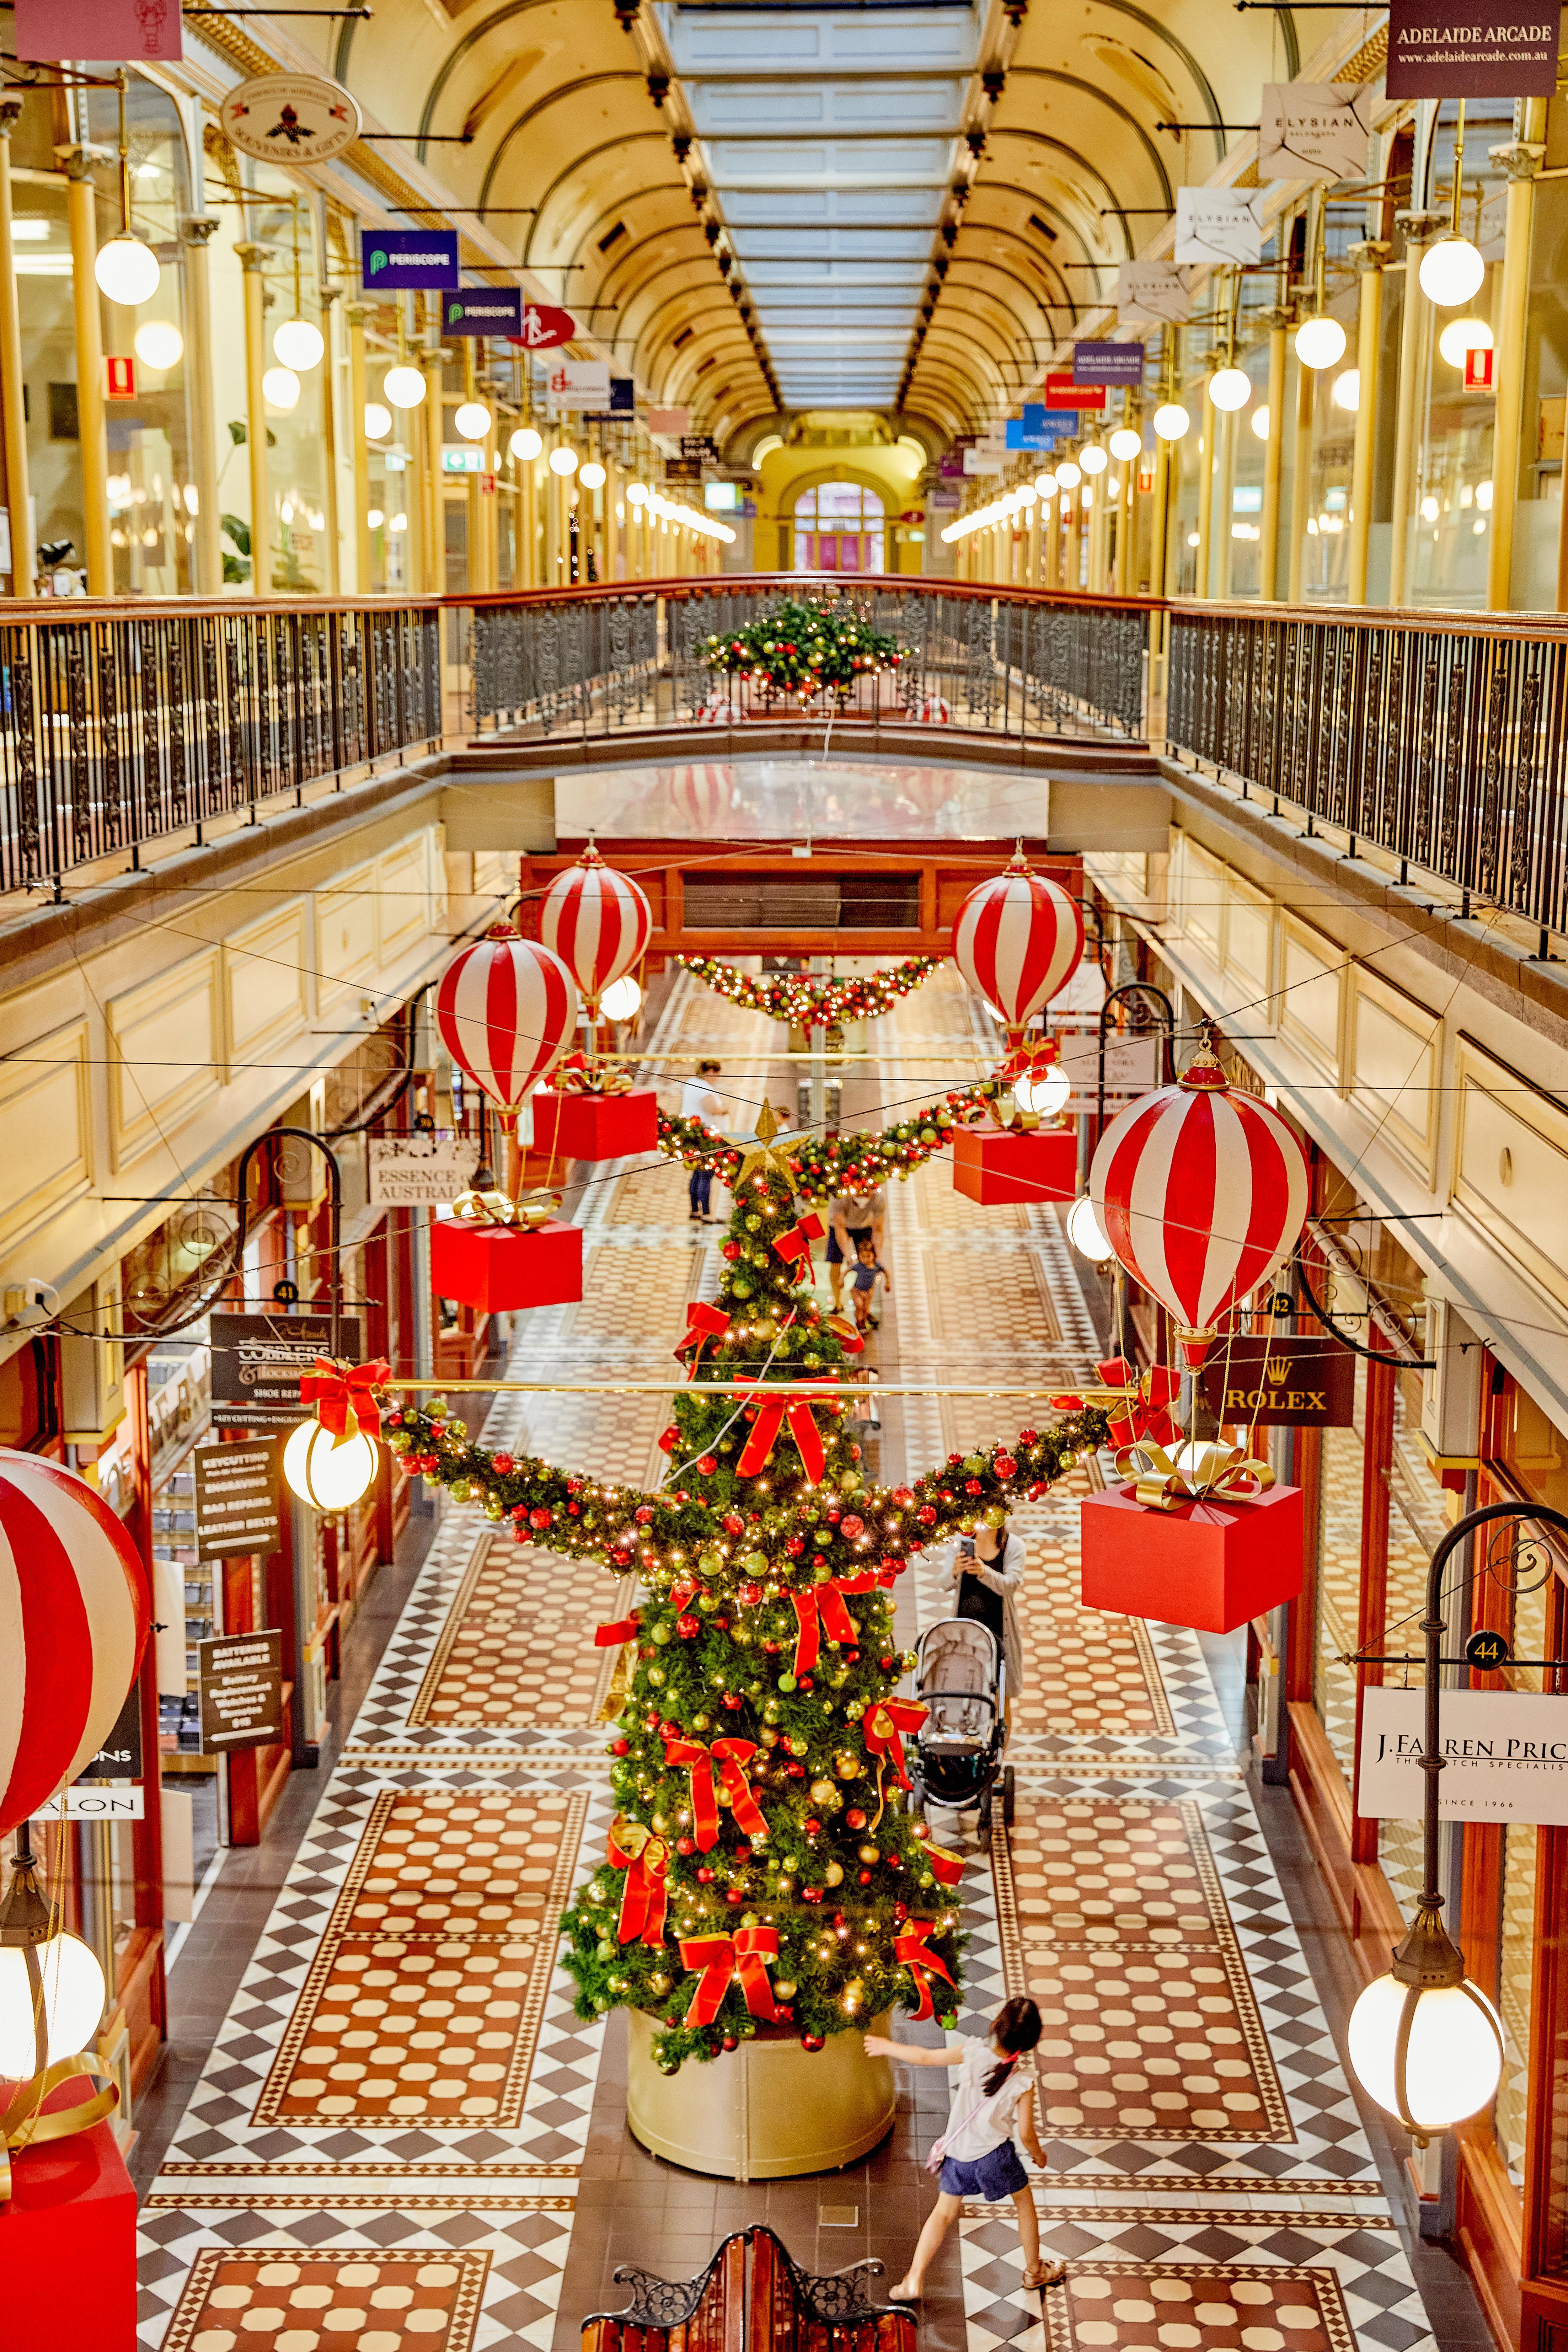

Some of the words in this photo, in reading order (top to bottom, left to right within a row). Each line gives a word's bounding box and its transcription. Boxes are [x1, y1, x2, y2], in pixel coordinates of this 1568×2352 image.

[1396, 27, 1482, 44] ADELAIDE
[1484, 25, 1552, 43] ARCADE
[1398, 50, 1548, 63] www.adelaidearcade.com.au
[1275, 117, 1353, 128] ELYSIAN
[235, 127, 301, 157] SOUVENIRS
[303, 148, 313, 157] &
[315, 130, 348, 153] GIFTS
[1189, 214, 1250, 223] ELYSIAN
[389, 254, 450, 266] PERISCOPE
[465, 306, 515, 317] PERISCOPE
[379, 1169, 456, 1183] ESSENCE
[379, 1185, 463, 1199] AUSTRALI
[278, 1286, 293, 1299] 41
[1275, 1299, 1289, 1312] 42
[253, 1389, 280, 1398] SHOE
[1226, 1390, 1327, 1410] ROLEX
[231, 1415, 267, 1423] CUTTING
[202, 1451, 269, 1469] KEYCUTTING
[205, 1477, 267, 1494] ENGRAVING
[202, 1502, 226, 1515] BAG
[226, 1496, 272, 1511] REPAIRS
[198, 1520, 245, 1536] LEATHER
[246, 1516, 278, 1529] BELTS
[213, 1643, 269, 1659] BATTERIES
[1475, 1642, 1499, 1659] 44
[212, 1654, 270, 1670] AVAILABLE
[222, 1674, 259, 1686] Battery
[1375, 1734, 1493, 1763] J.FAREN
[1507, 1739, 1567, 1759] PRIC
[1490, 1762, 1563, 1770] SPECIALIS
